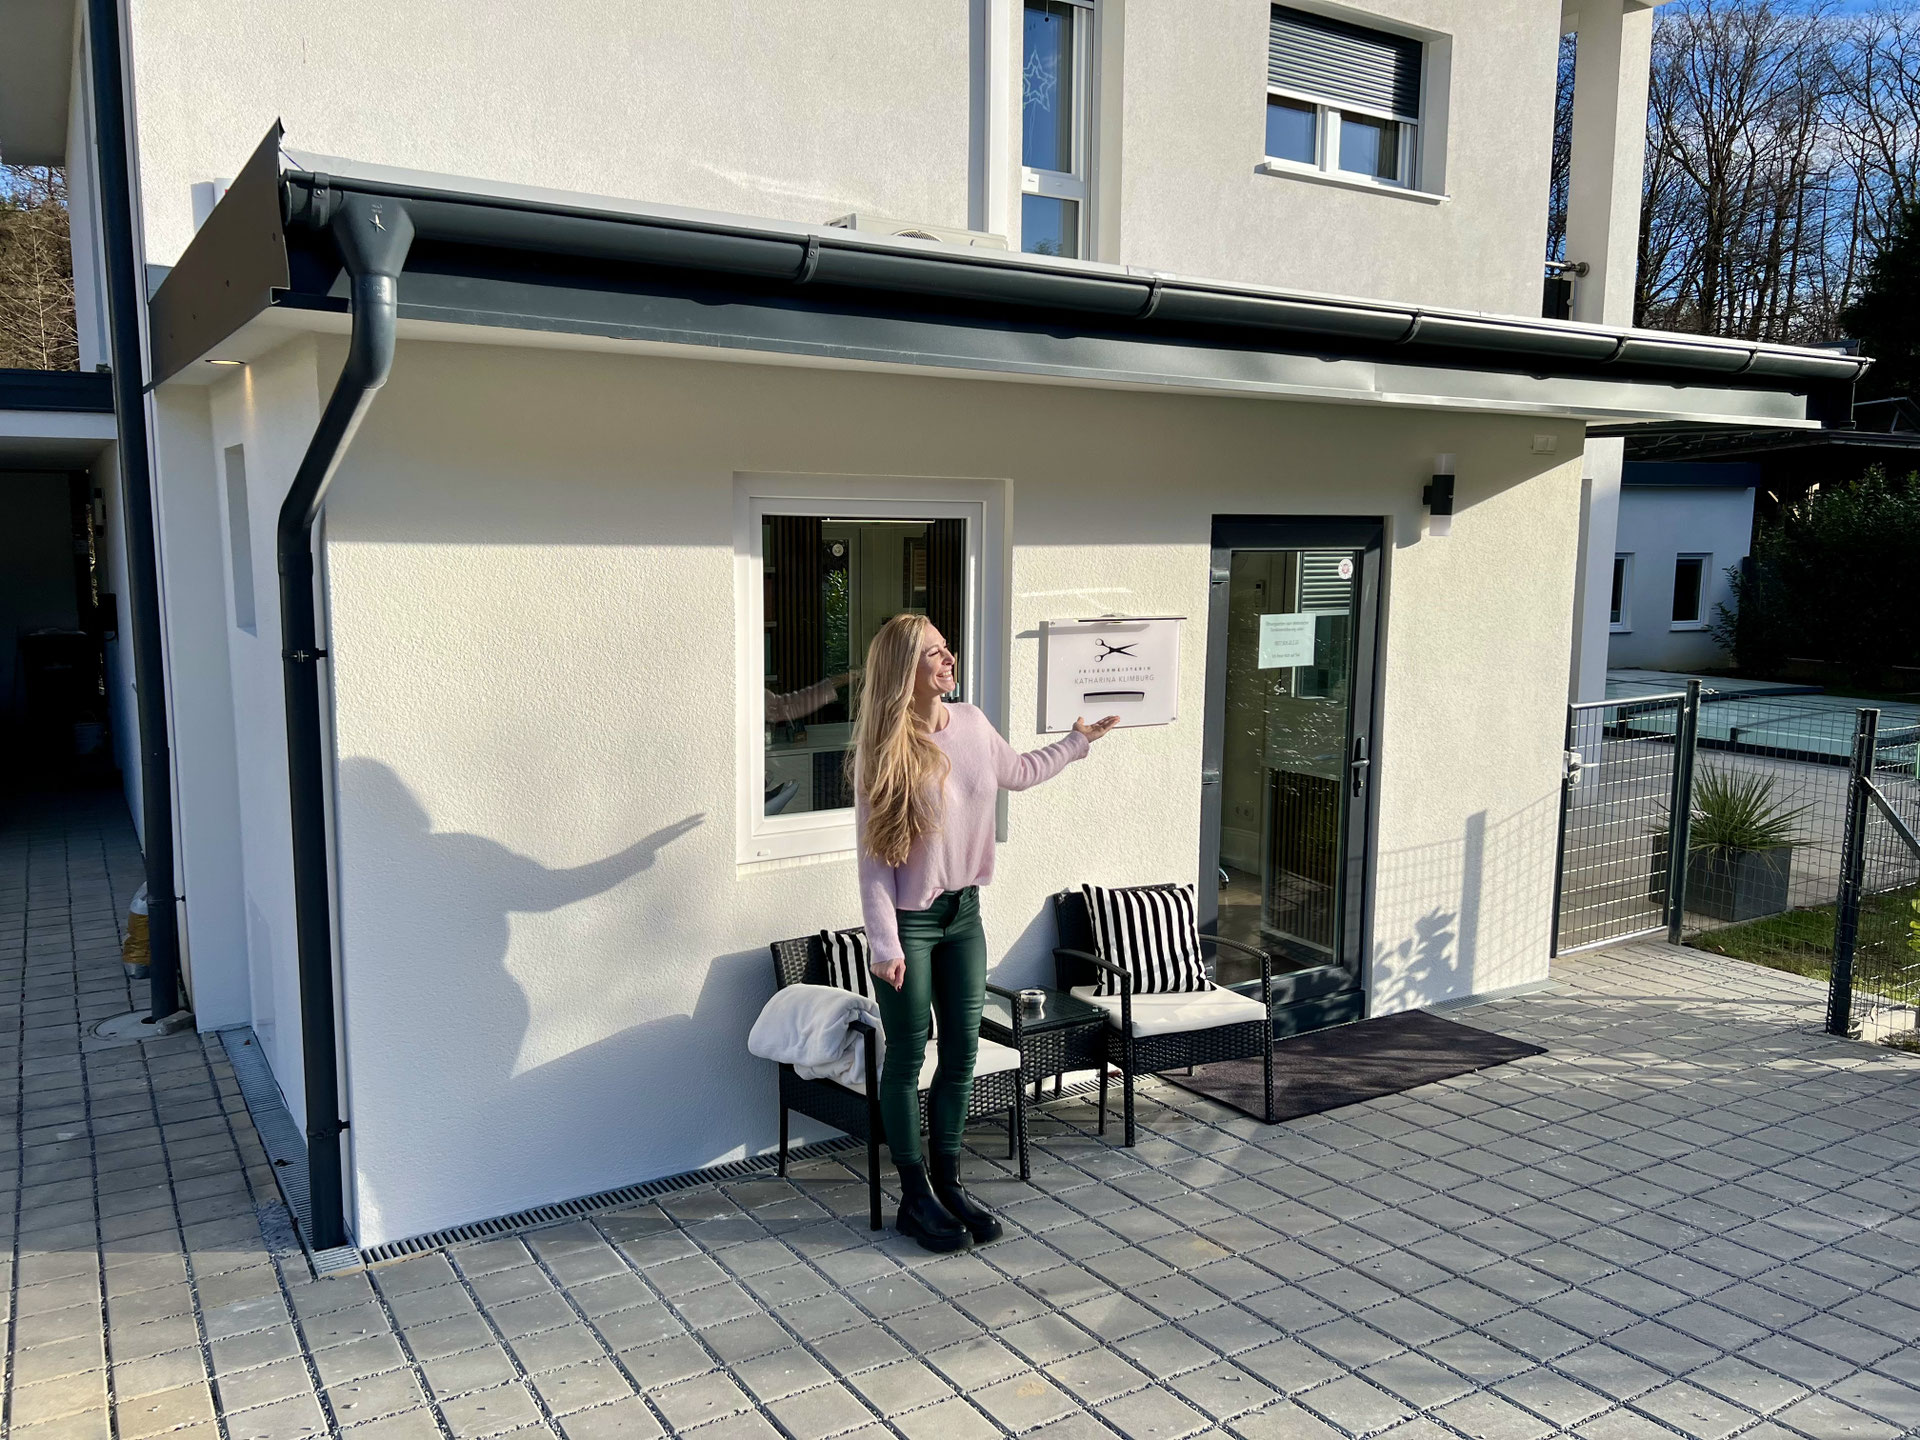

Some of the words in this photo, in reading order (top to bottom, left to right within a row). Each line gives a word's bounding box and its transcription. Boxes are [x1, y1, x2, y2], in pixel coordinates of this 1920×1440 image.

[1078, 666, 1151, 674] FRISEURMEISTERIN
[1074, 676, 1116, 684] KATHARINA
[1118, 674, 1154, 683] KLIMBURG
